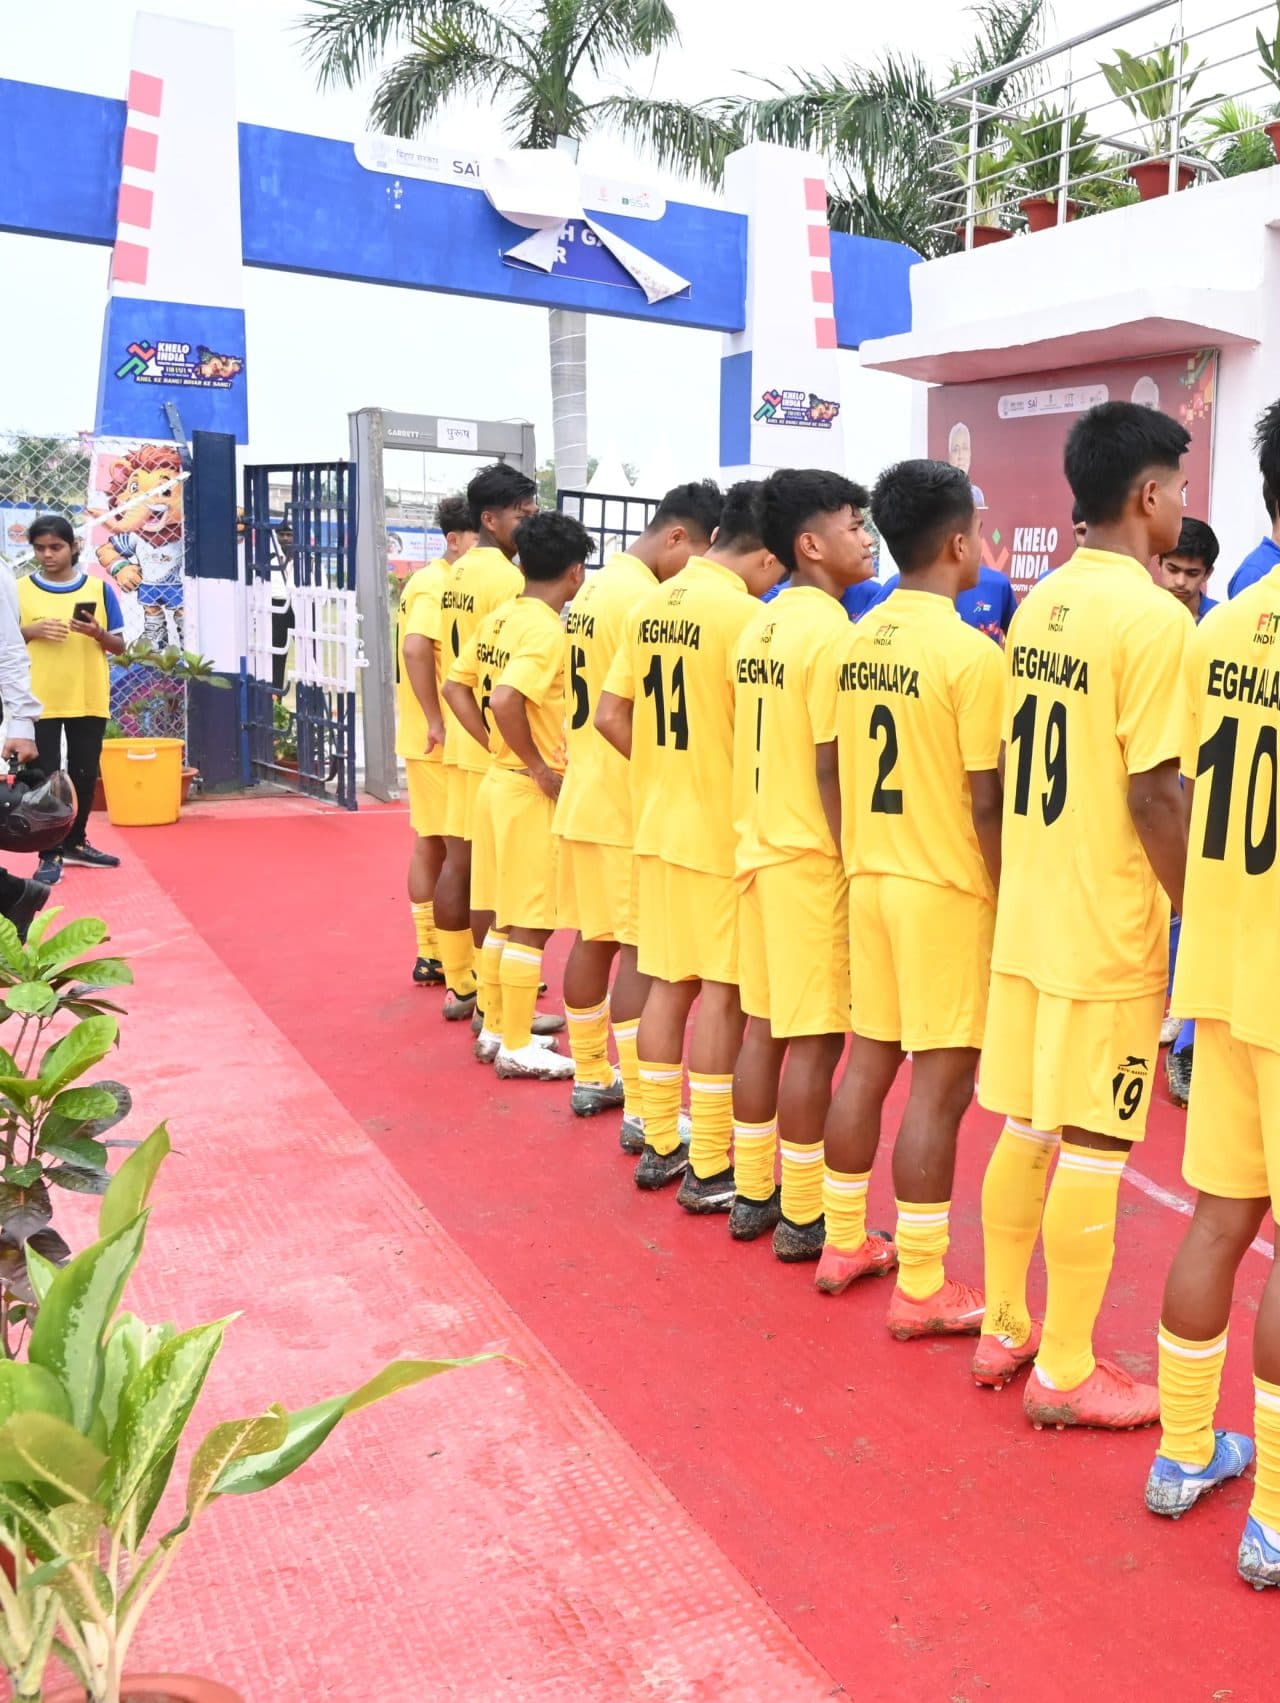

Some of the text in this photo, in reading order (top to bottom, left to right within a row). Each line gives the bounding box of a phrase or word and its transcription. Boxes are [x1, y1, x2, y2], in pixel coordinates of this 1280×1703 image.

[157, 351, 186, 363] INDIA
[158, 342, 190, 354] KHELO
[387, 428, 419, 438] GARRETT
[1013, 527, 1058, 552] KHELO
[1010, 554, 1049, 579] INDIA
[838, 662, 920, 699] MEGHALAYA
[643, 654, 689, 751] 14
[869, 704, 903, 814] 2
[1011, 693, 1067, 827] 19
[1195, 715, 1278, 876] 10
